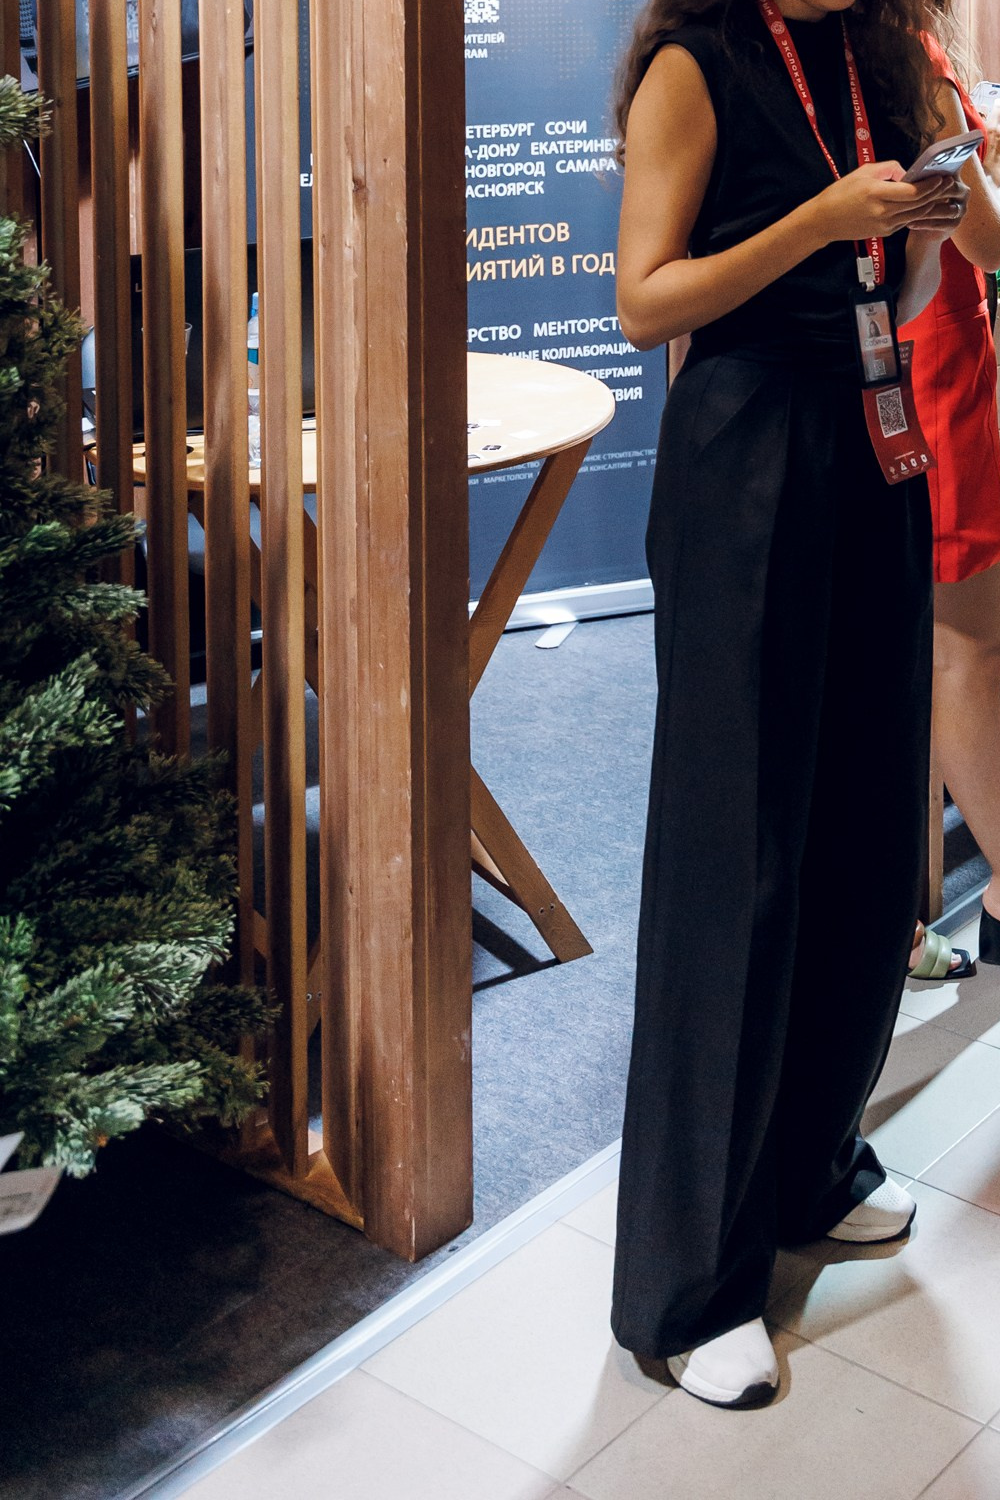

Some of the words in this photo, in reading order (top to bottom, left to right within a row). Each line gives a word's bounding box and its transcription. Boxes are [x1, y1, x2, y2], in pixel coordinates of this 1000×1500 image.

[464, 32, 505, 44] ИТЕЛЕЙ
[464, 48, 488, 59] RAM
[781, 40, 807, 98] ЭКСПОКРЫМ
[848, 67, 863, 122] ЭКСПОКРЫМ
[465, 122, 535, 139] ЕТЕРБУРГ
[545, 120, 587, 135] СОЧИ
[464, 143, 520, 160] А-ДОНУ
[465, 161, 545, 178] НОВГОРОД
[556, 158, 617, 173] САМАРА
[465, 181, 544, 198] АСНОЯРСК
[466, 222, 570, 251] ИДЕНТОВ
[466, 254, 544, 282] ИЯТИЙ
[551, 256, 565, 276] В
[572, 252, 615, 276] ГОД
[466, 324, 521, 343] РСТВО
[533, 316, 622, 337] МЕНТОРСТ
